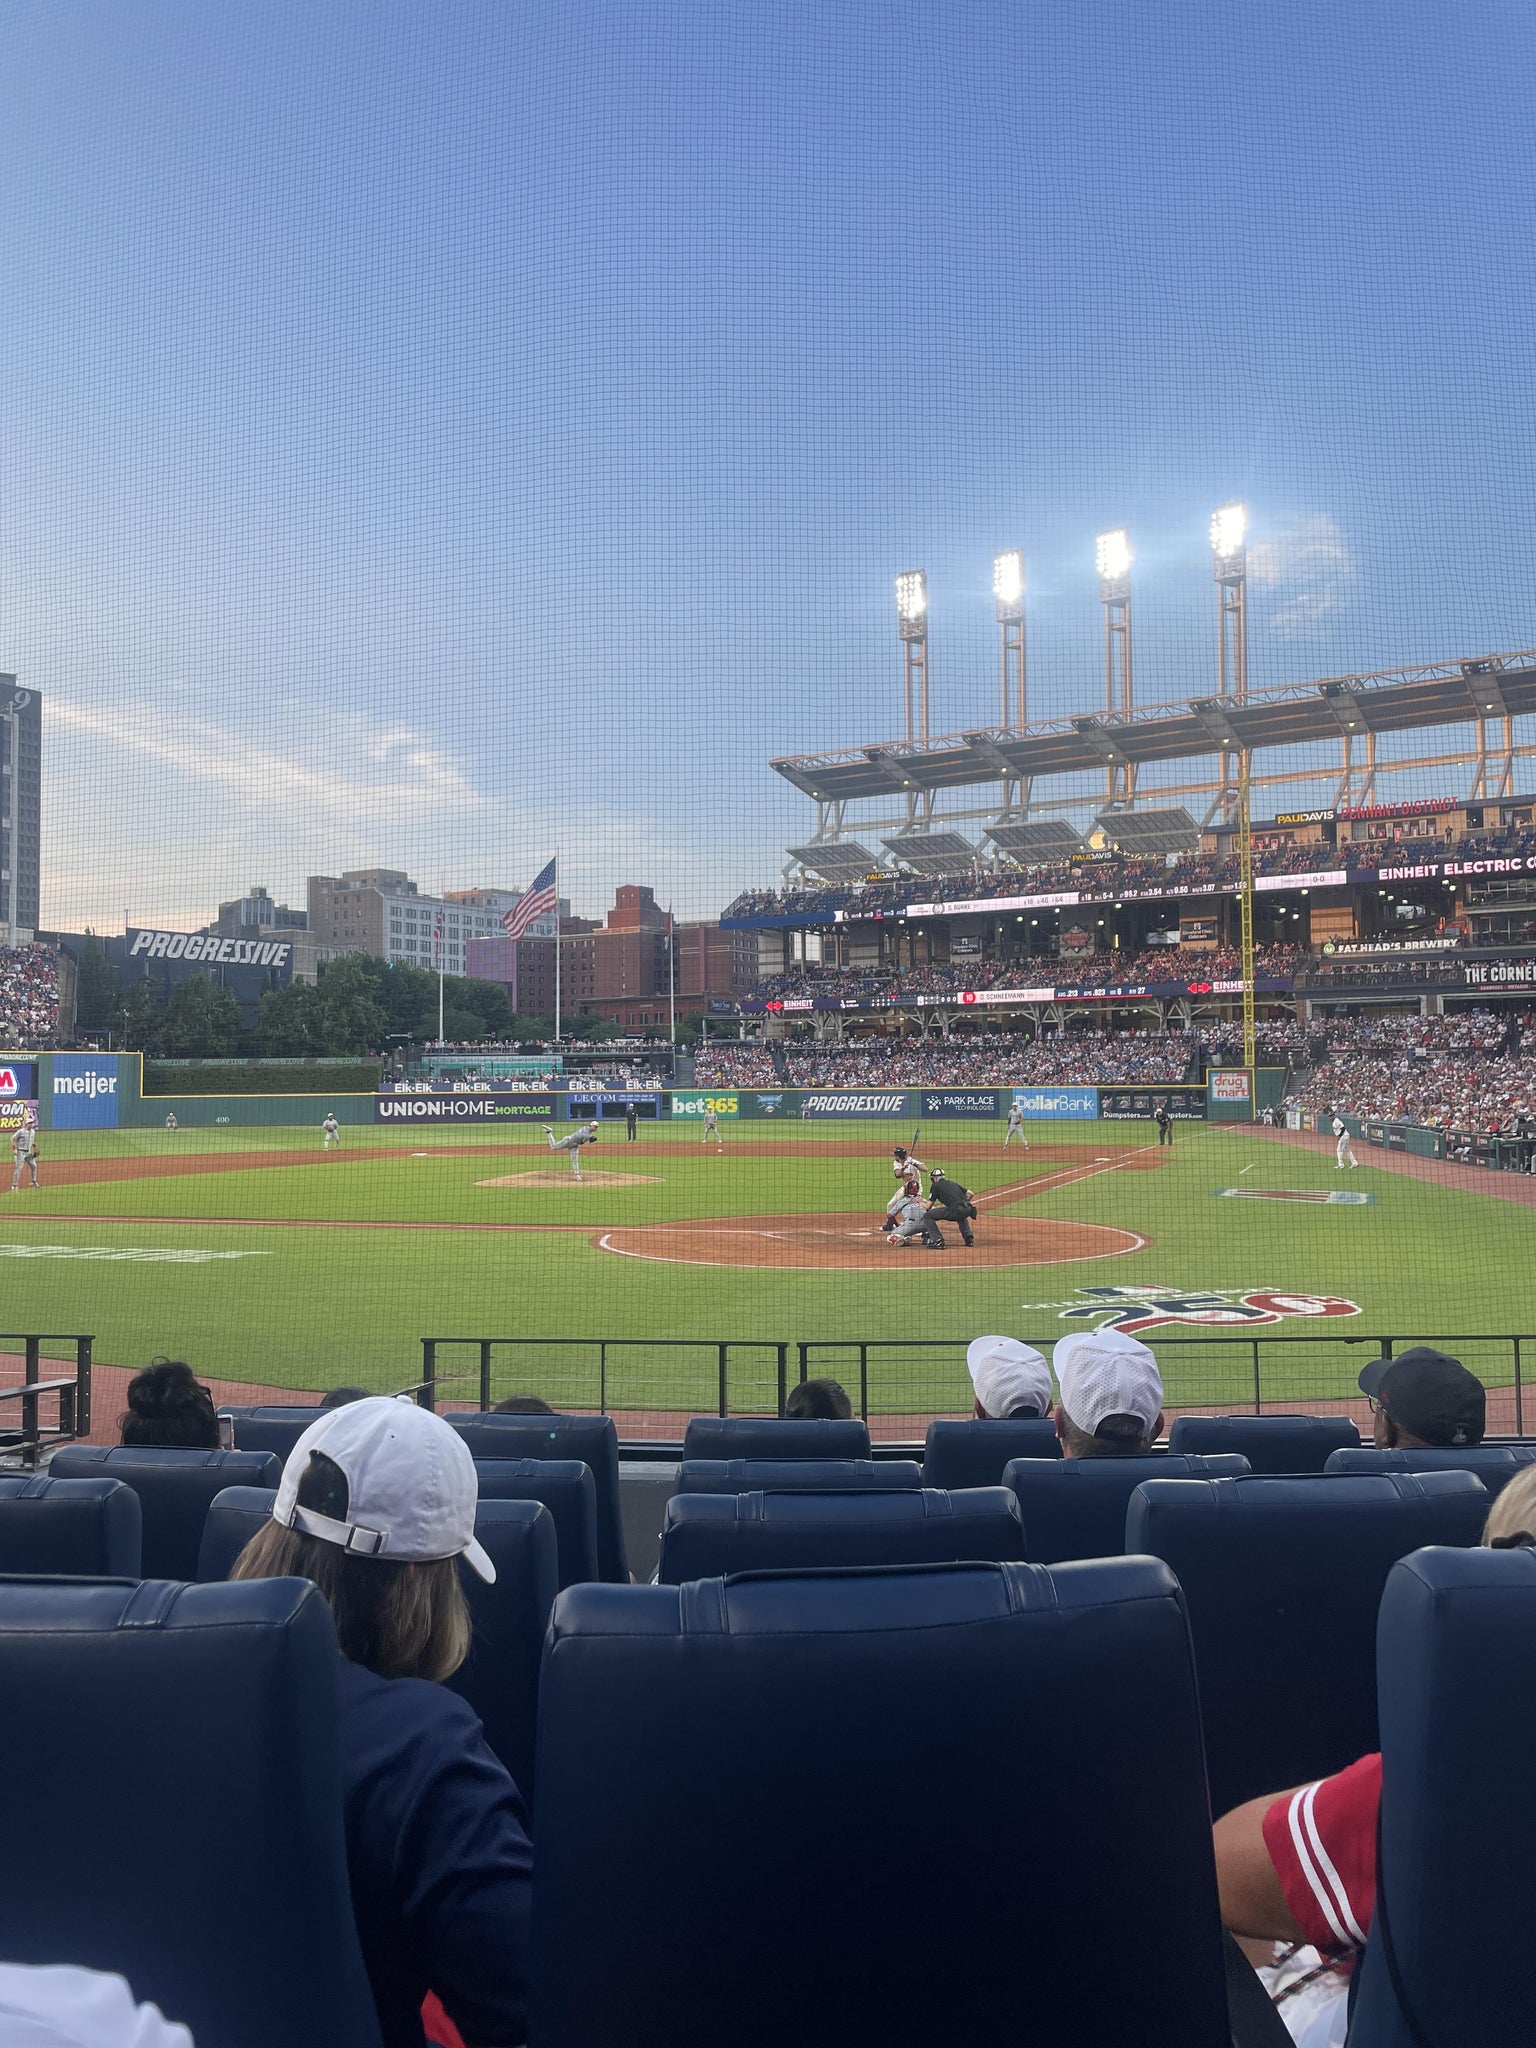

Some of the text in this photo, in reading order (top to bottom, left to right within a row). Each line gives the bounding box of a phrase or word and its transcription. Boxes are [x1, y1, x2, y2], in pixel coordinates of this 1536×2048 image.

[1341, 796, 1458, 821] PENNANT DISTRICT
[1379, 864, 1439, 881] EINHEIT
[1444, 857, 1522, 876] ELECTRIC
[130, 931, 291, 967] PROGRESSIVE
[1338, 939, 1459, 954] FAT HEAD'S BREWERY
[1464, 967, 1487, 983] THE
[986, 992, 1025, 1000] SCHNEEMANN
[784, 999, 813, 1008] EINHEIT
[201, 1058, 249, 1066] PROGRESSIVE
[259, 1057, 306, 1065] PROGRESSIVE
[316, 1056, 363, 1065] PROGRESSIVE
[54, 1071, 117, 1098] meijer
[1214, 1073, 1243, 1089] drug
[1217, 1088, 1248, 1097] mart
[672, 1097, 738, 1114] bet365
[808, 1095, 904, 1112] PROGRESSIVE
[944, 1095, 994, 1105] PARK PLACE
[495, 1106, 551, 1115] MORTGAGE
[1103, 1111, 1151, 1119] Dumpsters.com
[0, 1117, 23, 1128] RKS
[215, 1116, 230, 1124] 400
[1058, 1292, 1364, 1335] 250
